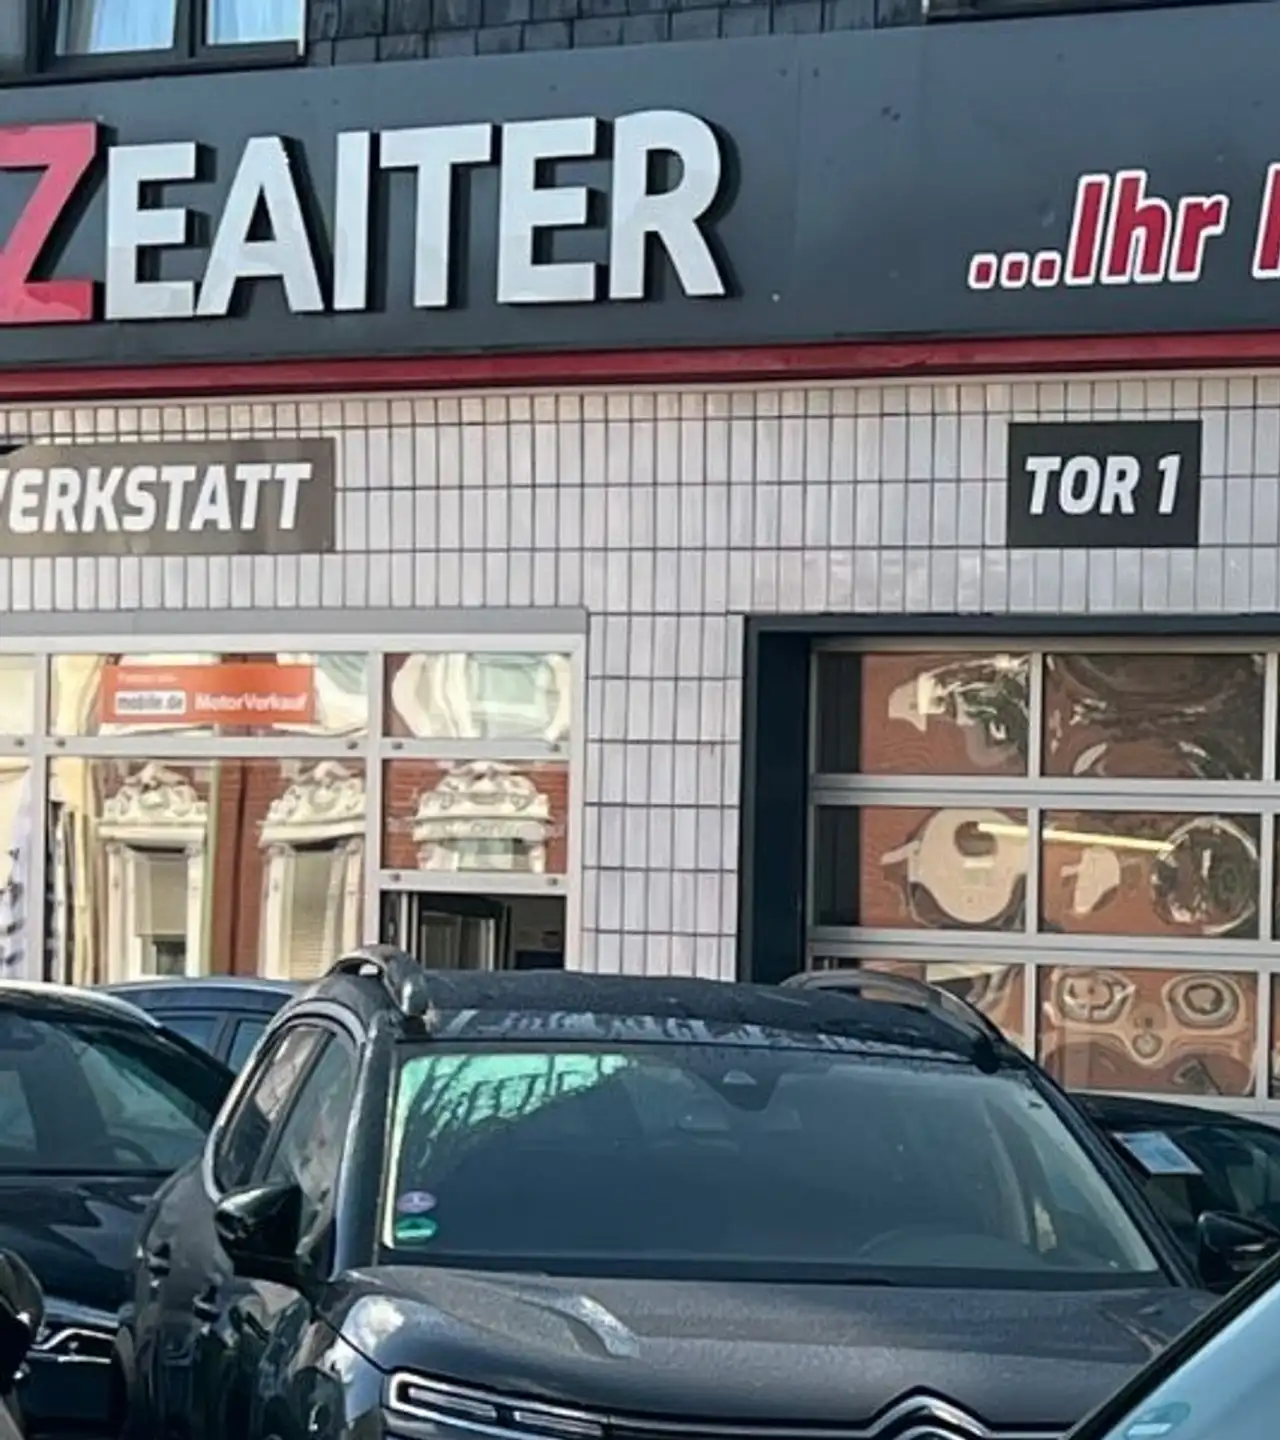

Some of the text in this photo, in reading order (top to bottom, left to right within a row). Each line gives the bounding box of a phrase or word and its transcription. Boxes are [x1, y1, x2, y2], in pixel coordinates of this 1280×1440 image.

[0, 109, 728, 323] ZEAITER
[0, 462, 312, 533] ERKSTATT
[1024, 453, 1181, 515] TOR 1
